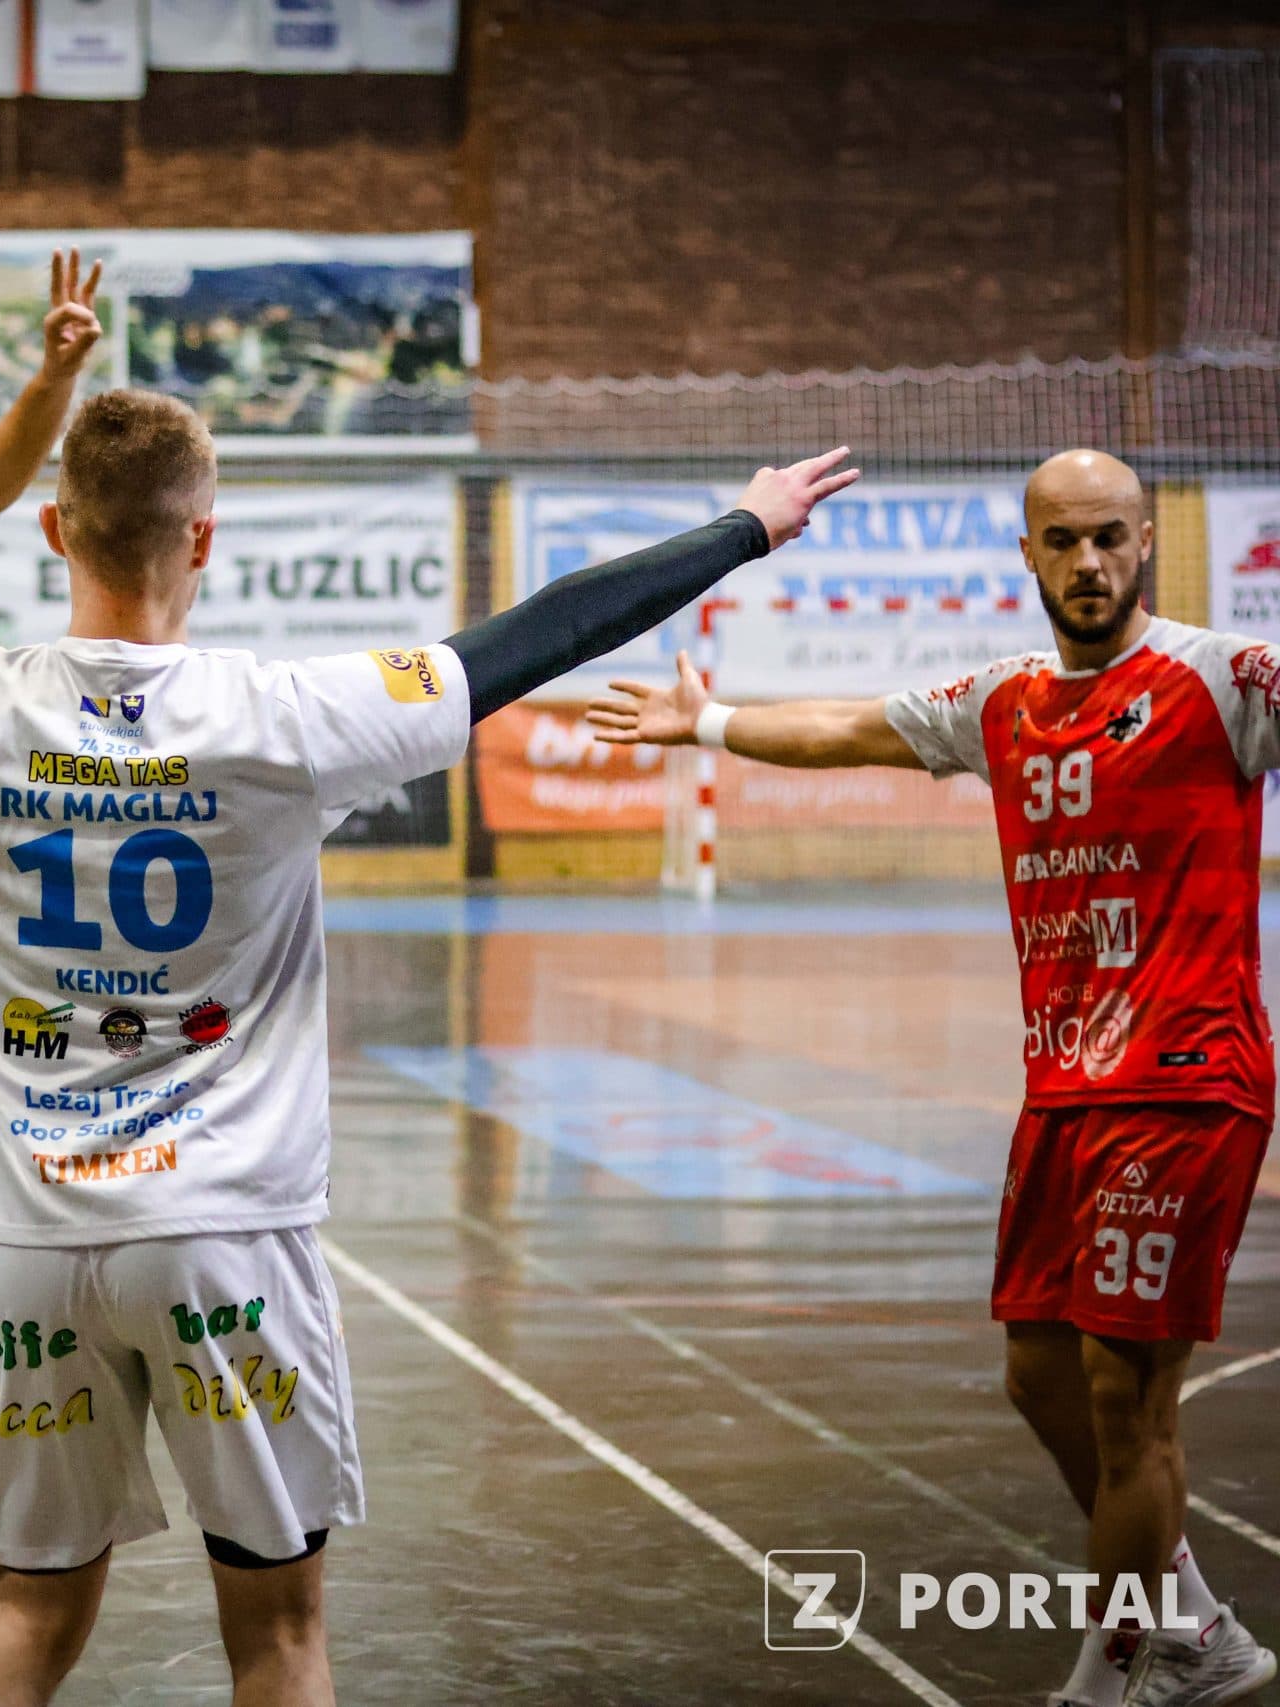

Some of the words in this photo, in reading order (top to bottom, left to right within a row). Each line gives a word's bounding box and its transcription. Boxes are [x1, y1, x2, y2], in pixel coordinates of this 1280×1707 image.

[233, 540, 446, 600] TUZLIĆ
[28, 750, 121, 786] MEGA
[125, 755, 189, 786] TAS
[1022, 750, 1094, 823] 39
[0, 787, 52, 820] RK
[63, 790, 217, 823] MAGLAJ
[1049, 842, 1141, 878] BANKA
[6, 827, 214, 953] 10
[56, 964, 170, 996] KENDIĆ
[3, 1027, 70, 1060] H-M
[24, 1085, 101, 1118] Ležaj
[109, 1080, 191, 1110] Trade
[10, 1118, 67, 1141] doo
[32, 1140, 177, 1185] TIMKEN
[1093, 1226, 1177, 1301] 39
[169, 1296, 266, 1345] bar
